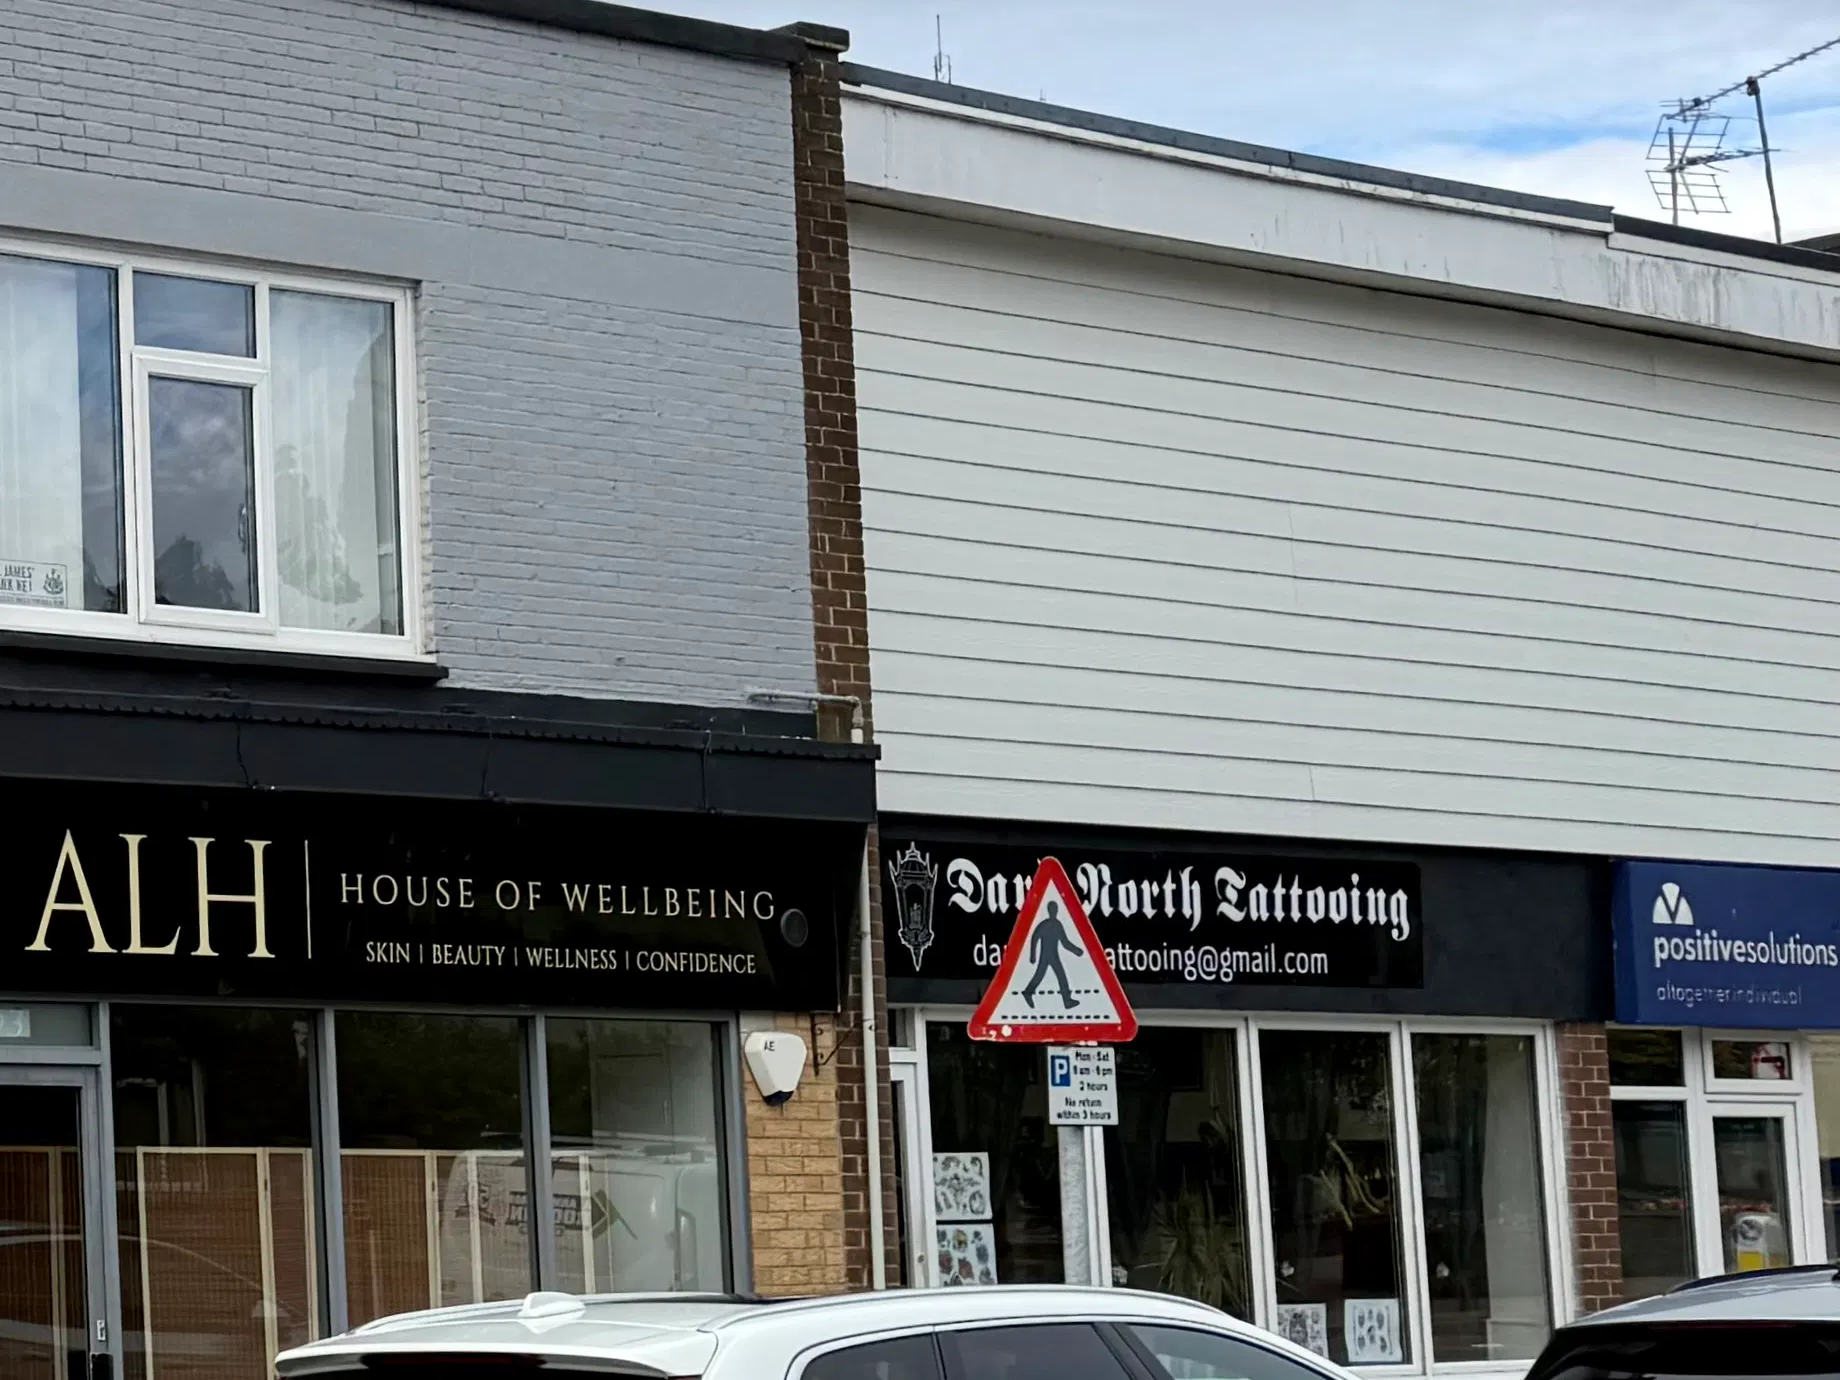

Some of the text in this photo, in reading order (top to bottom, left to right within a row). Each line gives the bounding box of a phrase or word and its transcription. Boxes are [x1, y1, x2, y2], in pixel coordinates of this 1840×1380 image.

[23, 829, 276, 959] ALH
[340, 873, 776, 921] HOUSE OF WELLBEING
[946, 857, 1411, 943] Dar North Tattooing
[365, 940, 757, 975] SKIN BEAUTY WELLNESS CONFIDENCE
[1654, 928, 1838, 969] positivesolutions
